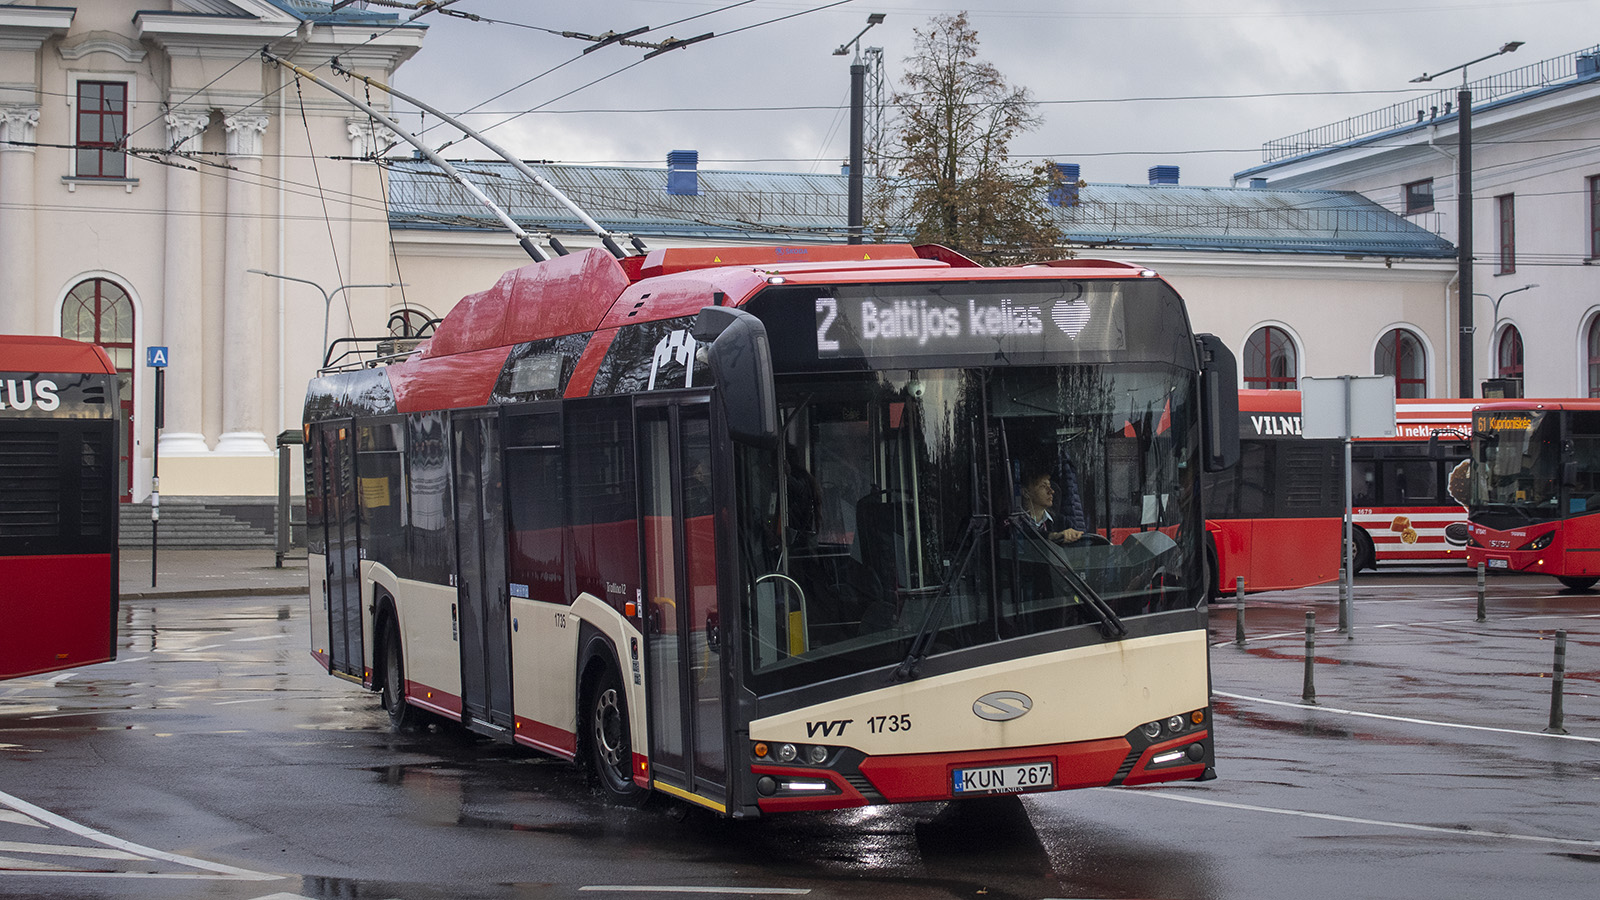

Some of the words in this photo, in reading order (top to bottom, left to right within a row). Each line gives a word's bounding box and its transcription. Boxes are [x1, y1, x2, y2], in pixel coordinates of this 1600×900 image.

[815, 297, 840, 351] 2
[861, 299, 961, 346] Baltijos
[968, 299, 1043, 335] kelias
[152, 349, 167, 364] A
[1250, 415, 1302, 435] VILNI
[1477, 416, 1487, 432] 61
[554, 613, 567, 629] 1735
[866, 714, 912, 734] 1735
[954, 782, 963, 790] LT
[964, 769, 1005, 790] KUN
[1017, 766, 1050, 786] 267
[995, 786, 1025, 795] VILNIUS
